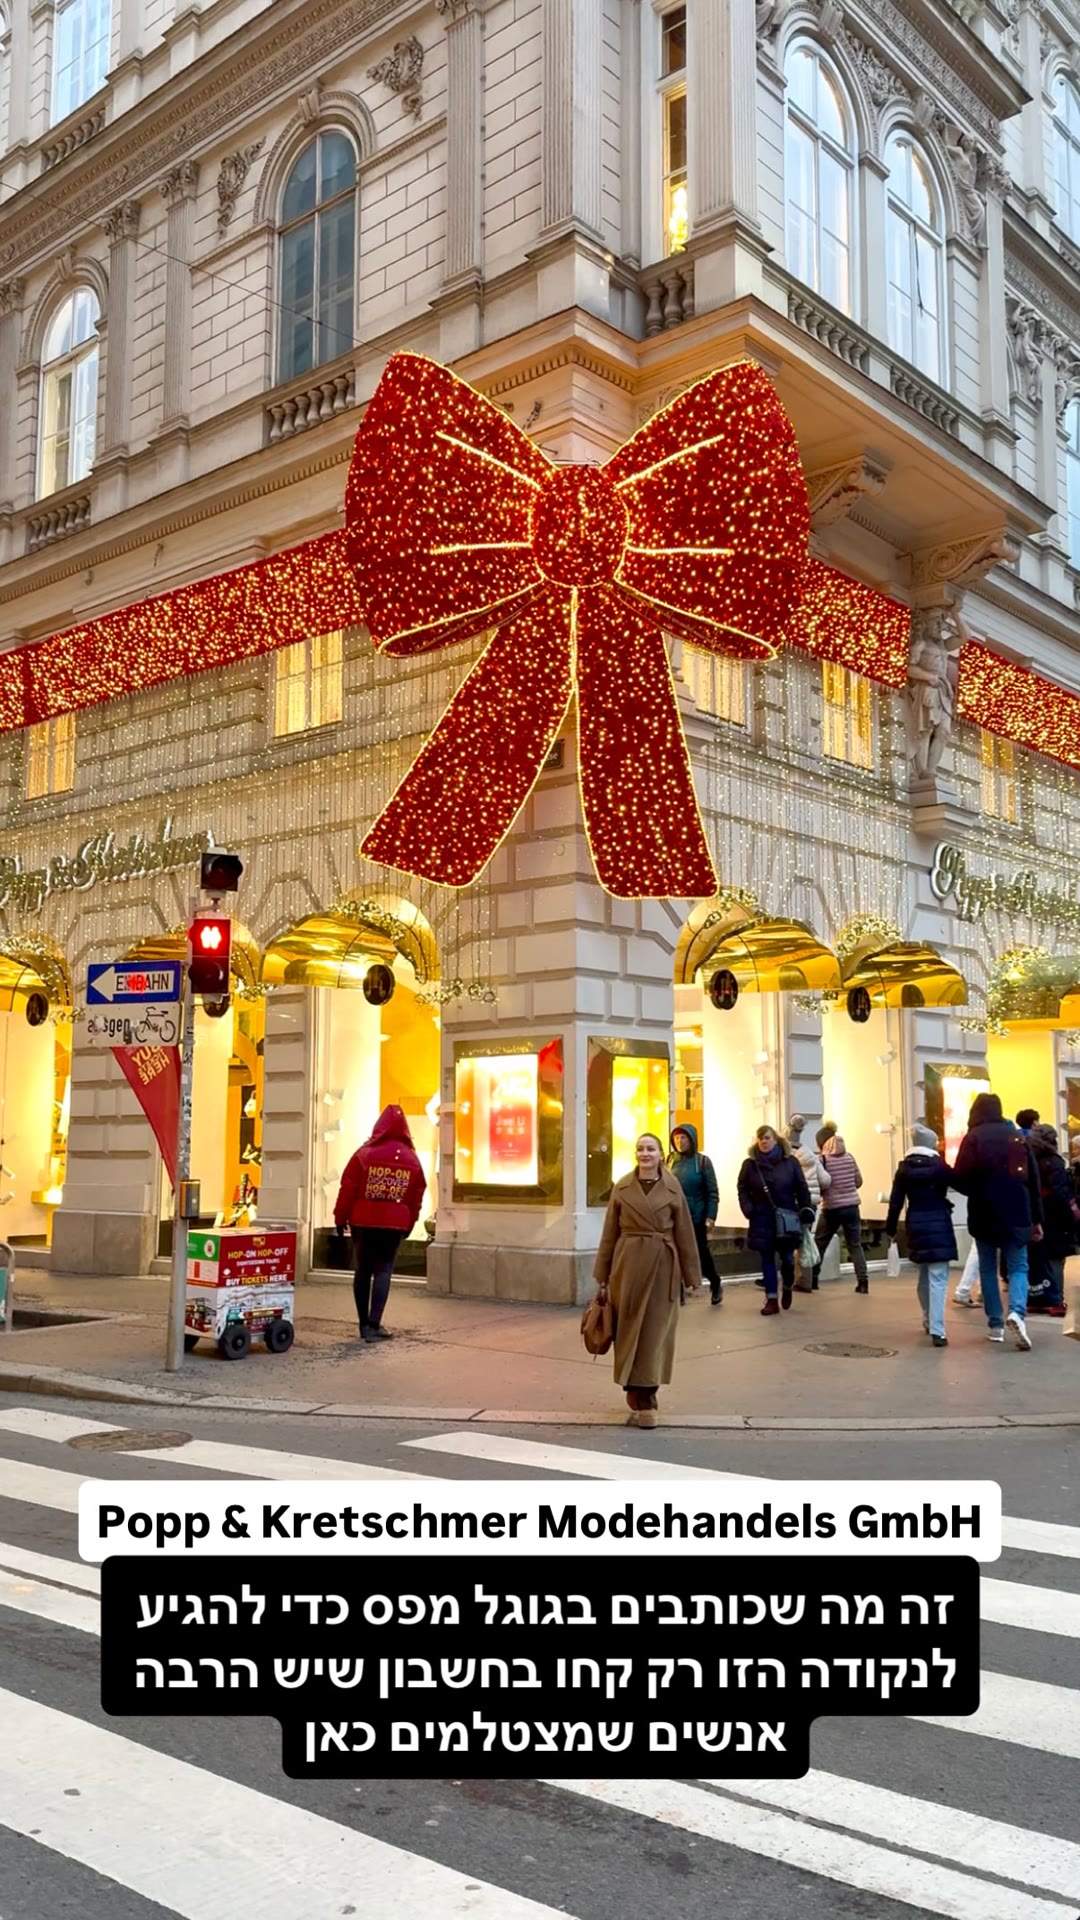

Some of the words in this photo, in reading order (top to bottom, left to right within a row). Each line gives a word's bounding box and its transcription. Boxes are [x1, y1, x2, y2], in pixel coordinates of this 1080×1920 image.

[368, 1166, 411, 1180] HOP-ON
[367, 1176, 409, 1187] DISCOVER
[366, 1184, 408, 1195] HOP-OFF
[228, 1250, 257, 1259] HOP-ON
[258, 1248, 289, 1257] HOP-OFF
[242, 1275, 269, 1285] TICKETS
[270, 1274, 288, 1282] HERE
